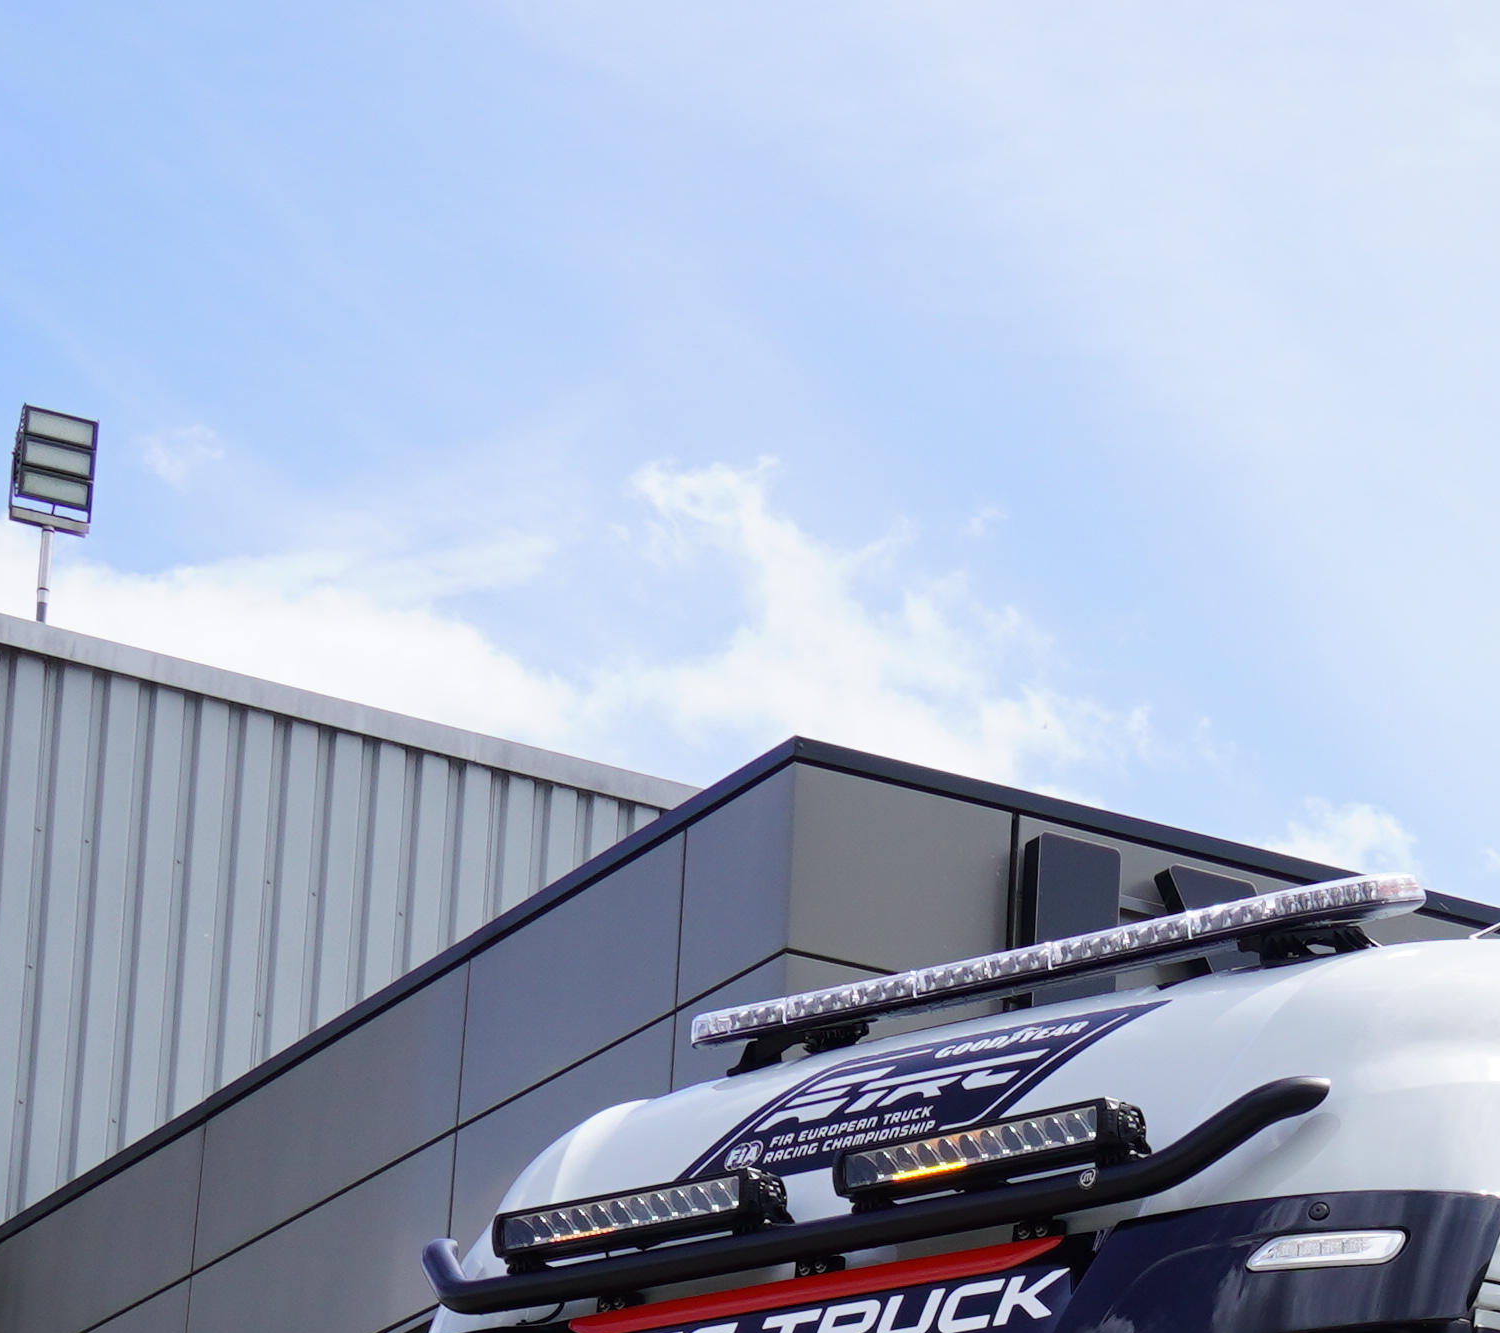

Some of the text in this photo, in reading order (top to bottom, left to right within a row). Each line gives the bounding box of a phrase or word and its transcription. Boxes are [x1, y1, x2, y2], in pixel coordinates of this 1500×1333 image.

[934, 1020, 1090, 1058] GOODYEAR
[763, 1120, 936, 1164] RACING CHAMPIONSHIP
[769, 1105, 935, 1149] FIA EUROPEAN TRUCK
